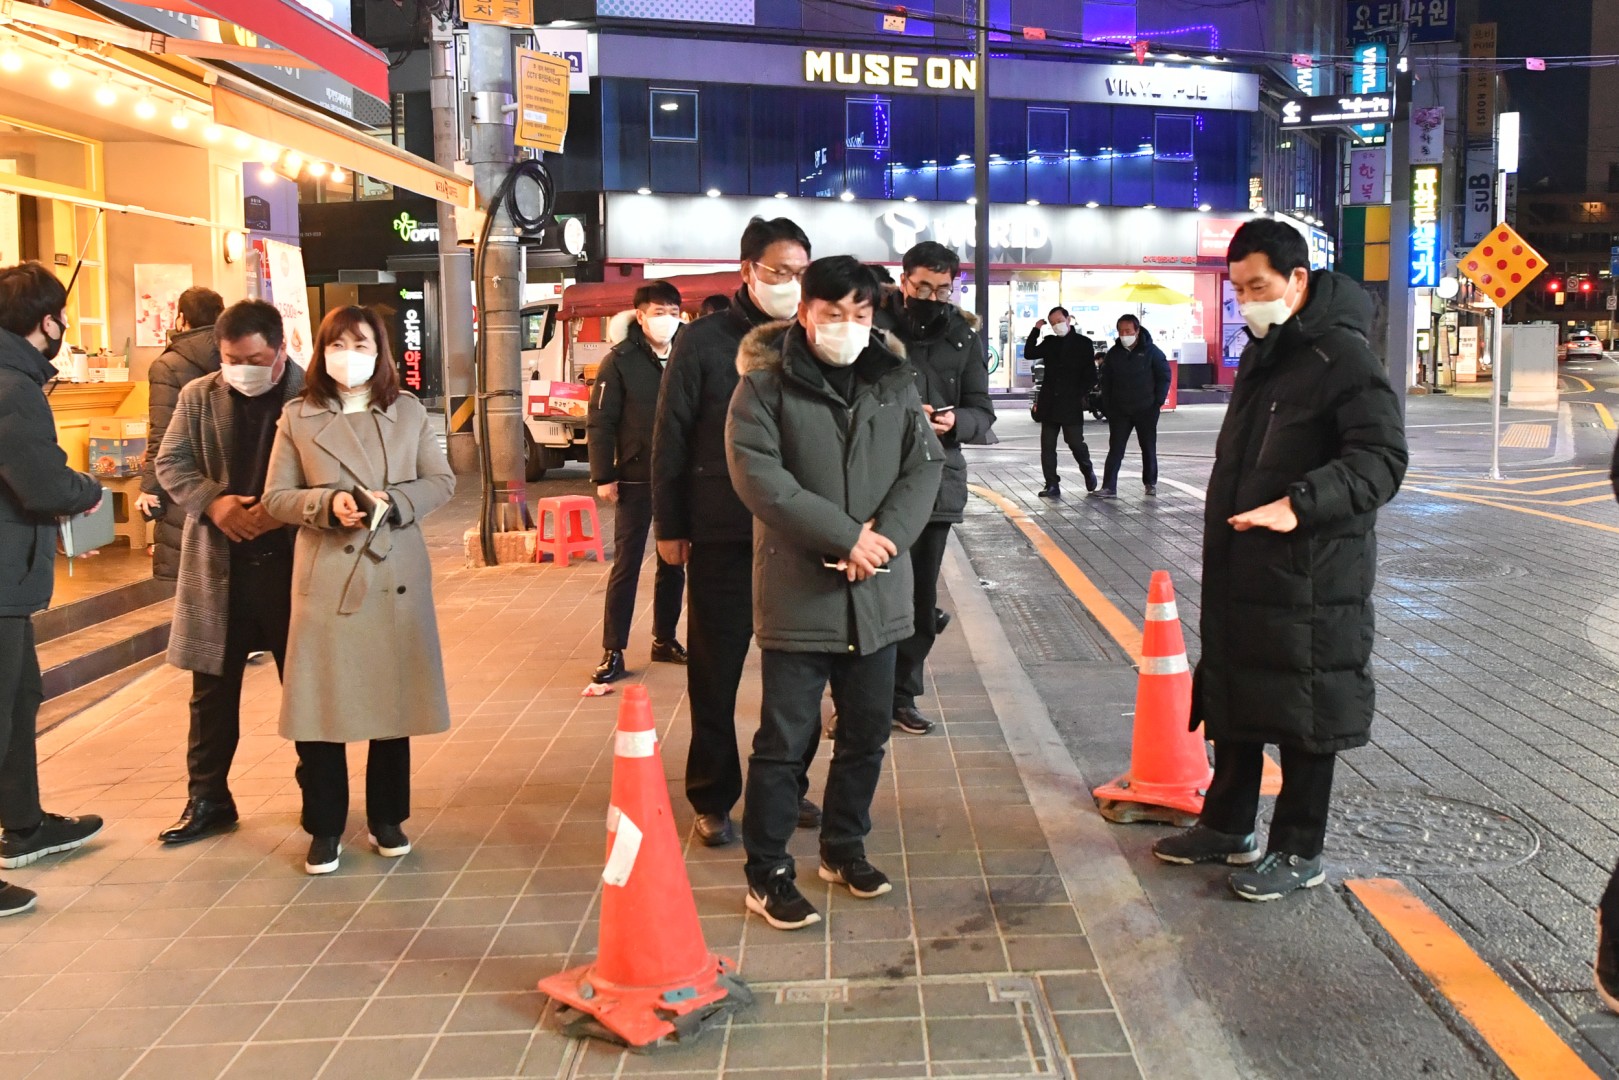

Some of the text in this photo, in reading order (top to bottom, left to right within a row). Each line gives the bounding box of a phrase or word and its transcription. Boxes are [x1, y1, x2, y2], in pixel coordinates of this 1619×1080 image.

[1362, 47, 1376, 94] VINYL
[1359, 163, 1376, 200] 한복
[1469, 173, 1490, 212] SUB
